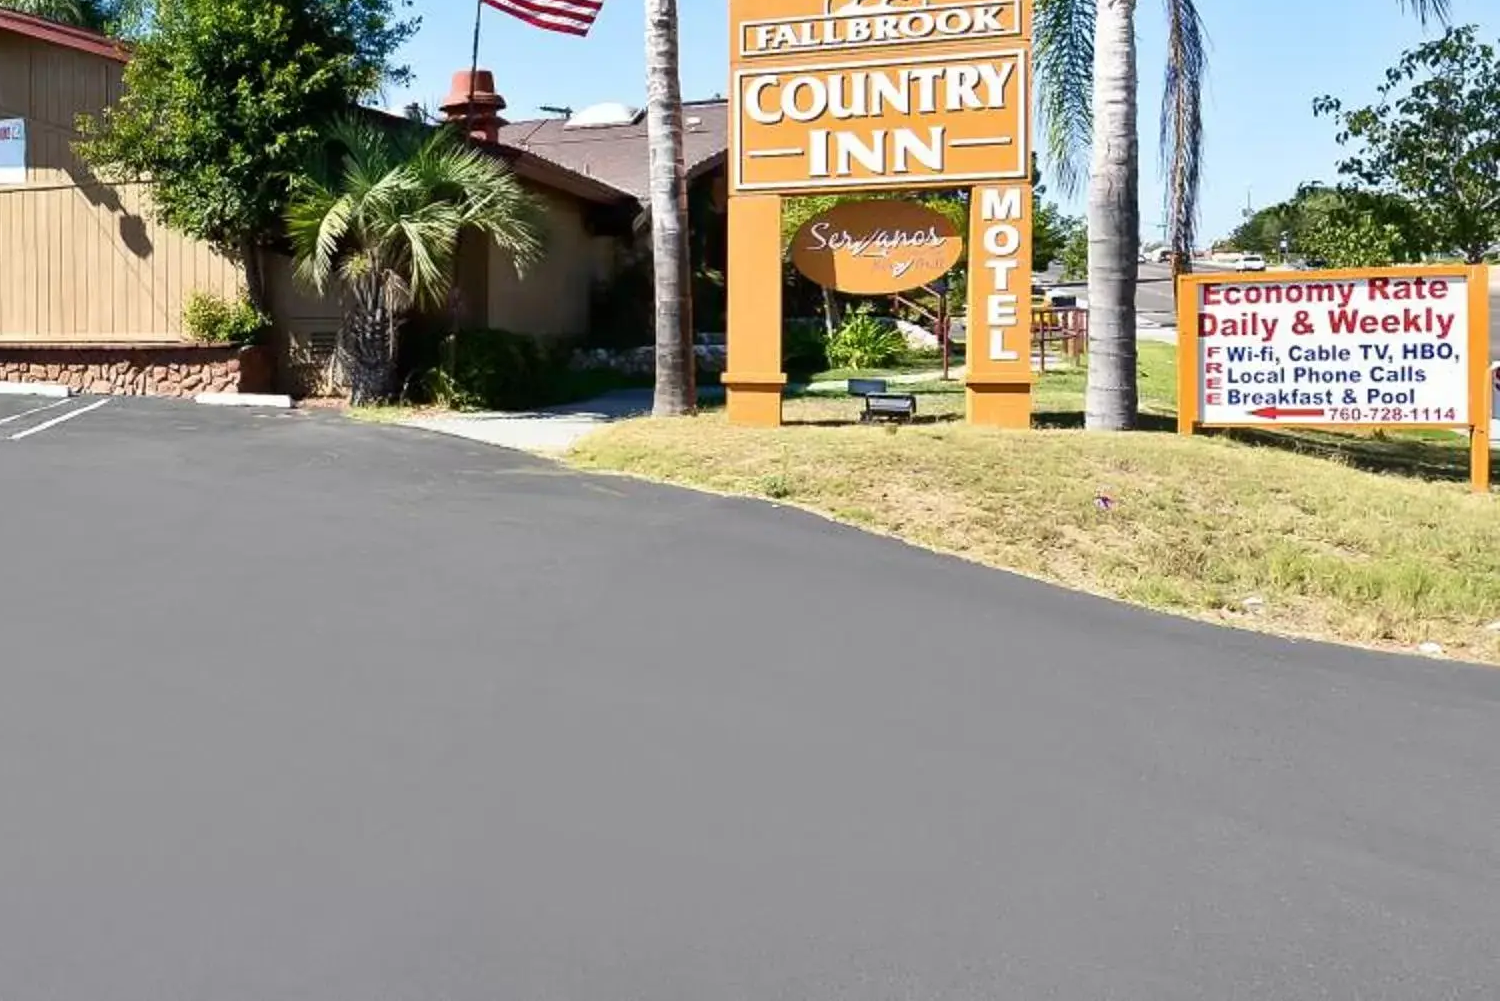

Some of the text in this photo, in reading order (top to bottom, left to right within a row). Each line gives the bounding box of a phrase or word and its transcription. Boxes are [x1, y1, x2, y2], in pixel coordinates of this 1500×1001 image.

[756, 5, 1004, 51] FALLBROOK
[745, 62, 1016, 125] COUNTRY
[808, 125, 946, 177] INN
[981, 187, 1023, 360] MOTEL
[1202, 276, 1449, 308] Economy Rate
[1198, 307, 1455, 342] Daily & Weekly
[1226, 342, 1461, 365] Wi-fi, Cable TV, HBO,
[1205, 346, 1223, 406] FREE
[1227, 365, 1427, 385] Local Phone Calls
[1227, 387, 1416, 406] Breakfast & Pool
[1328, 407, 1456, 422] 760-728-1114
